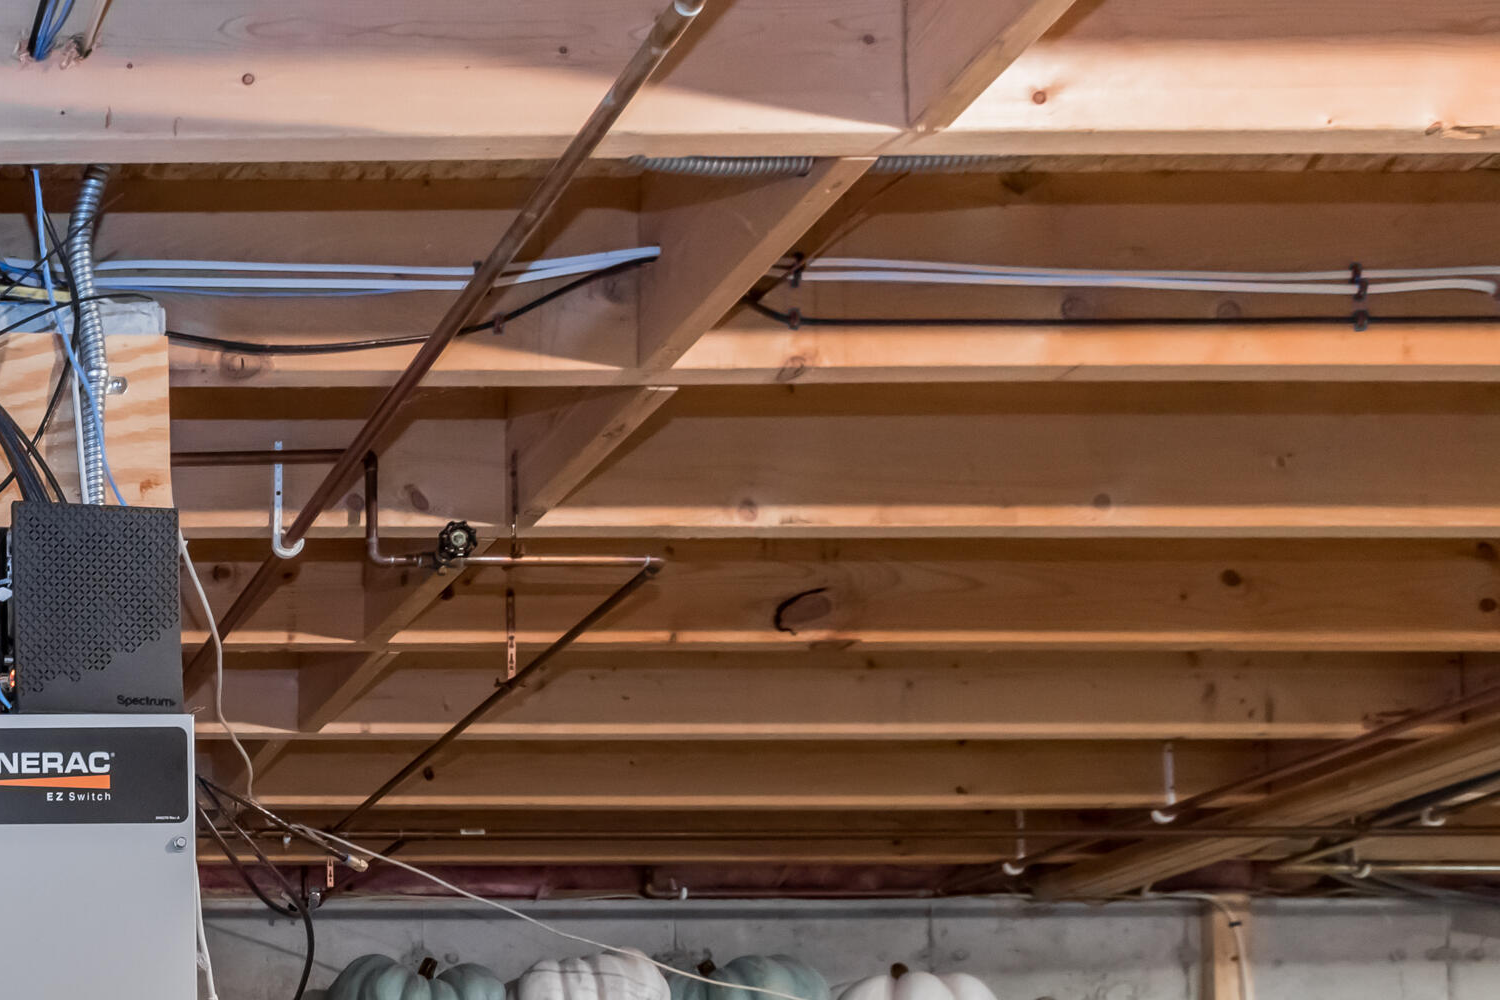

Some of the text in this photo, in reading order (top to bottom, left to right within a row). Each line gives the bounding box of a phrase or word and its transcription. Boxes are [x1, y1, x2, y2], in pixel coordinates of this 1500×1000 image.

[116, 695, 173, 707] Spectrum
[46, 792, 112, 801] EZ Switch
